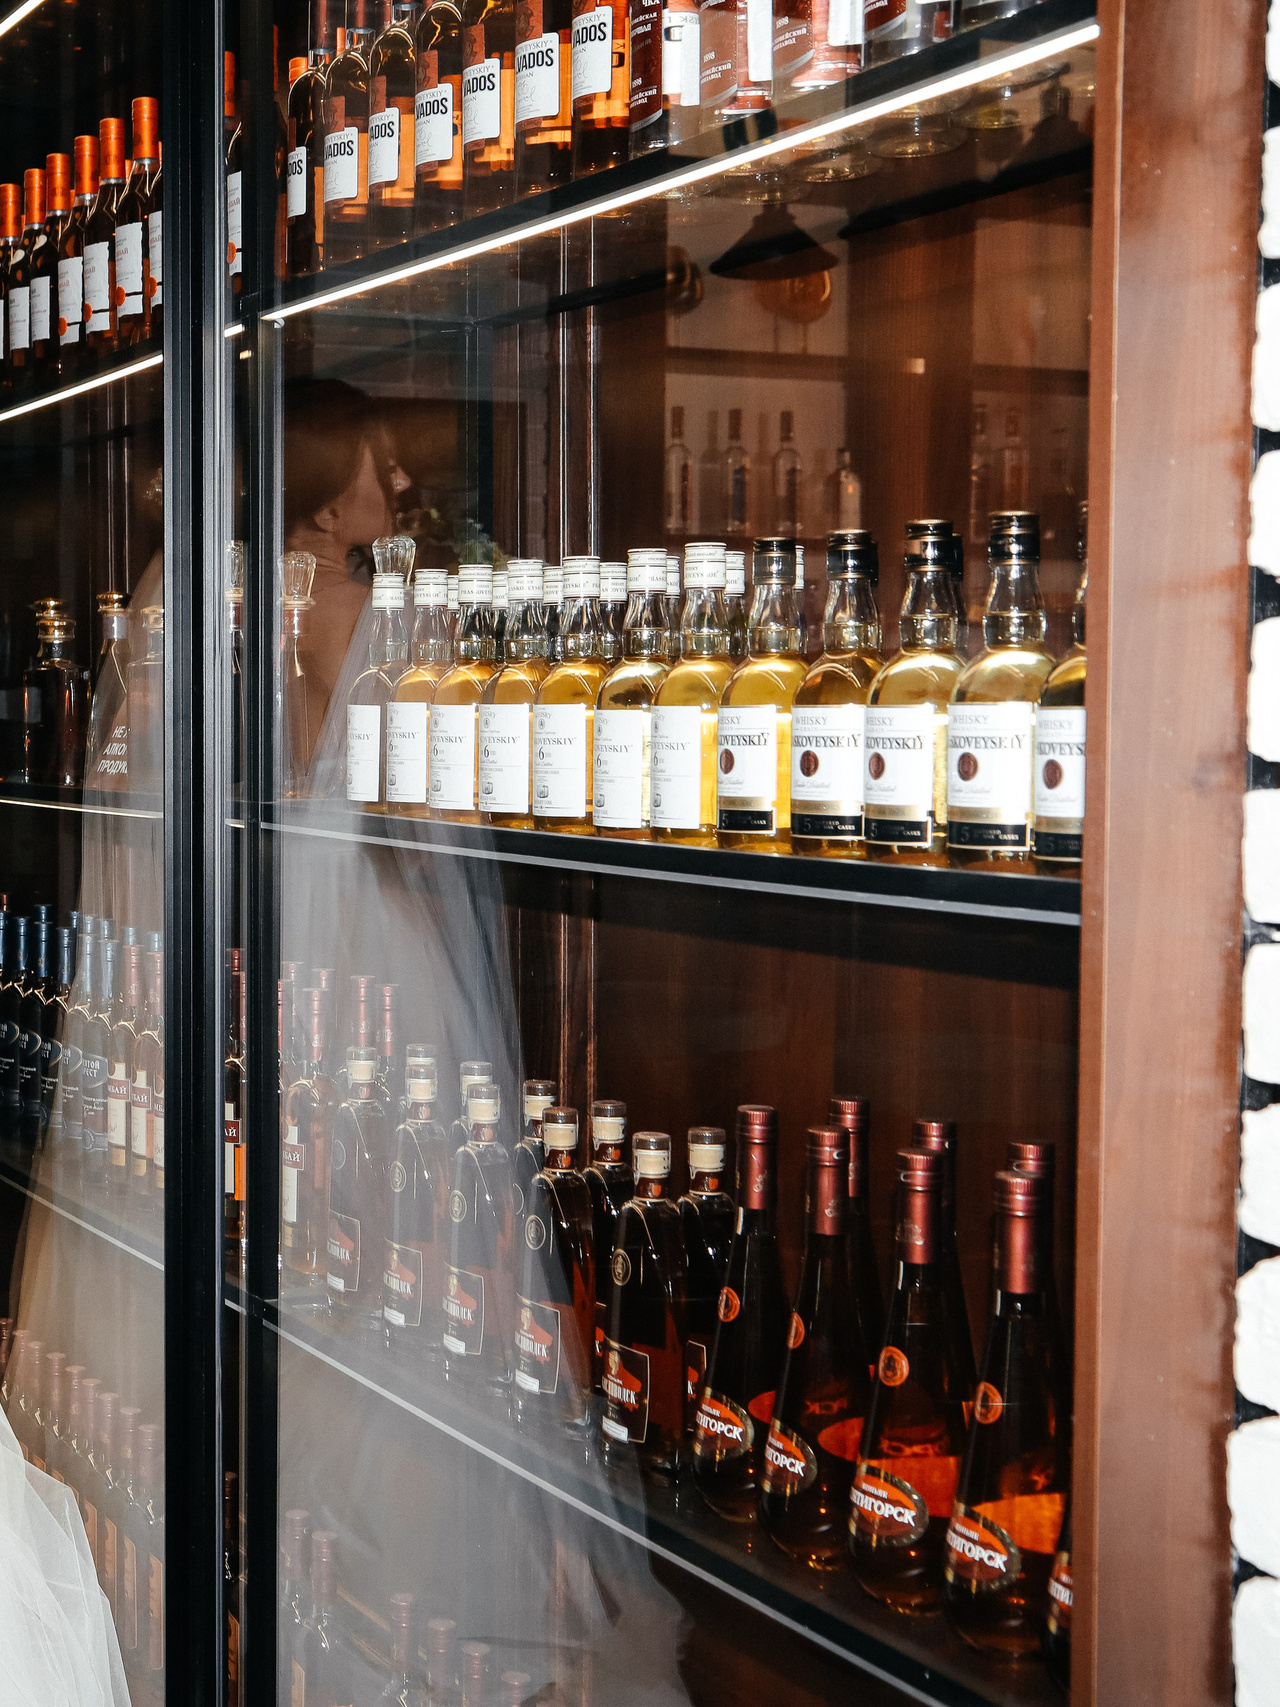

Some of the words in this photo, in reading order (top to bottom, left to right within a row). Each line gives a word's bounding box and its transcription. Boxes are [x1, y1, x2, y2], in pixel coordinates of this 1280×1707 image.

[573, 22, 607, 48] VADOS
[516, 48, 554, 74] VADOS
[464, 73, 496, 97] VADOS
[415, 97, 448, 120] VADOS
[369, 121, 395, 142] ADOS
[324, 140, 354, 161] VADOS
[103, 743, 127, 755] АЛКО
[696, 1410, 744, 1442] ТИГОРСК
